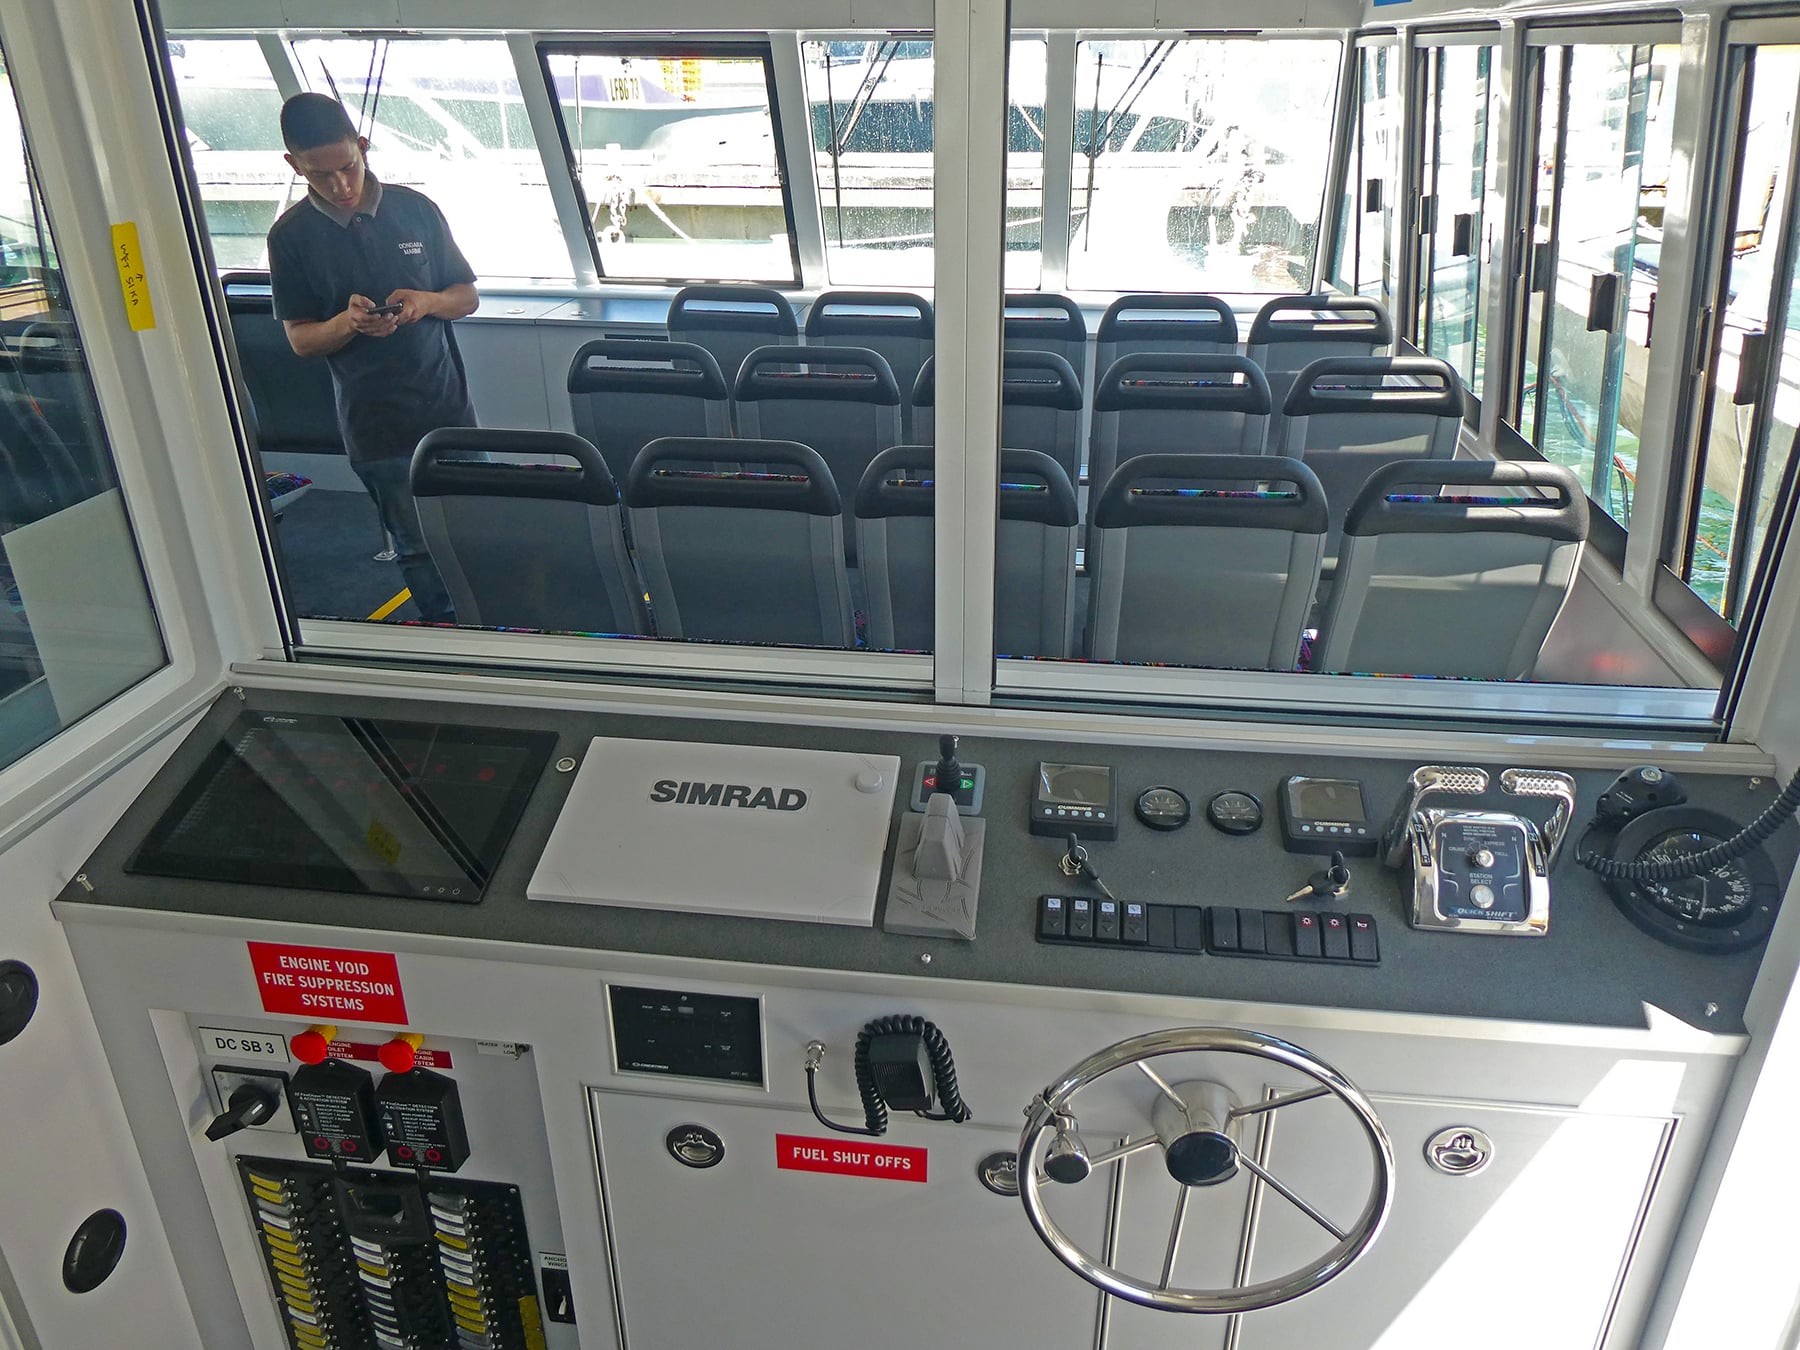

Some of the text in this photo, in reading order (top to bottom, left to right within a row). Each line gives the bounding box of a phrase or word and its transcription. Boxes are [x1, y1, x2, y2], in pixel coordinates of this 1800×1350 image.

[126, 276, 138, 306] SIKA
[650, 780, 807, 811] SIMRAD
[280, 956, 369, 975] ENGINE VOID
[264, 972, 395, 996] FIRE SUPPRESSION
[302, 994, 364, 1011] SYSTEMS
[216, 1038, 274, 1054] DC SB 3
[793, 1147, 911, 1169] FUEL SHUT OFFS
